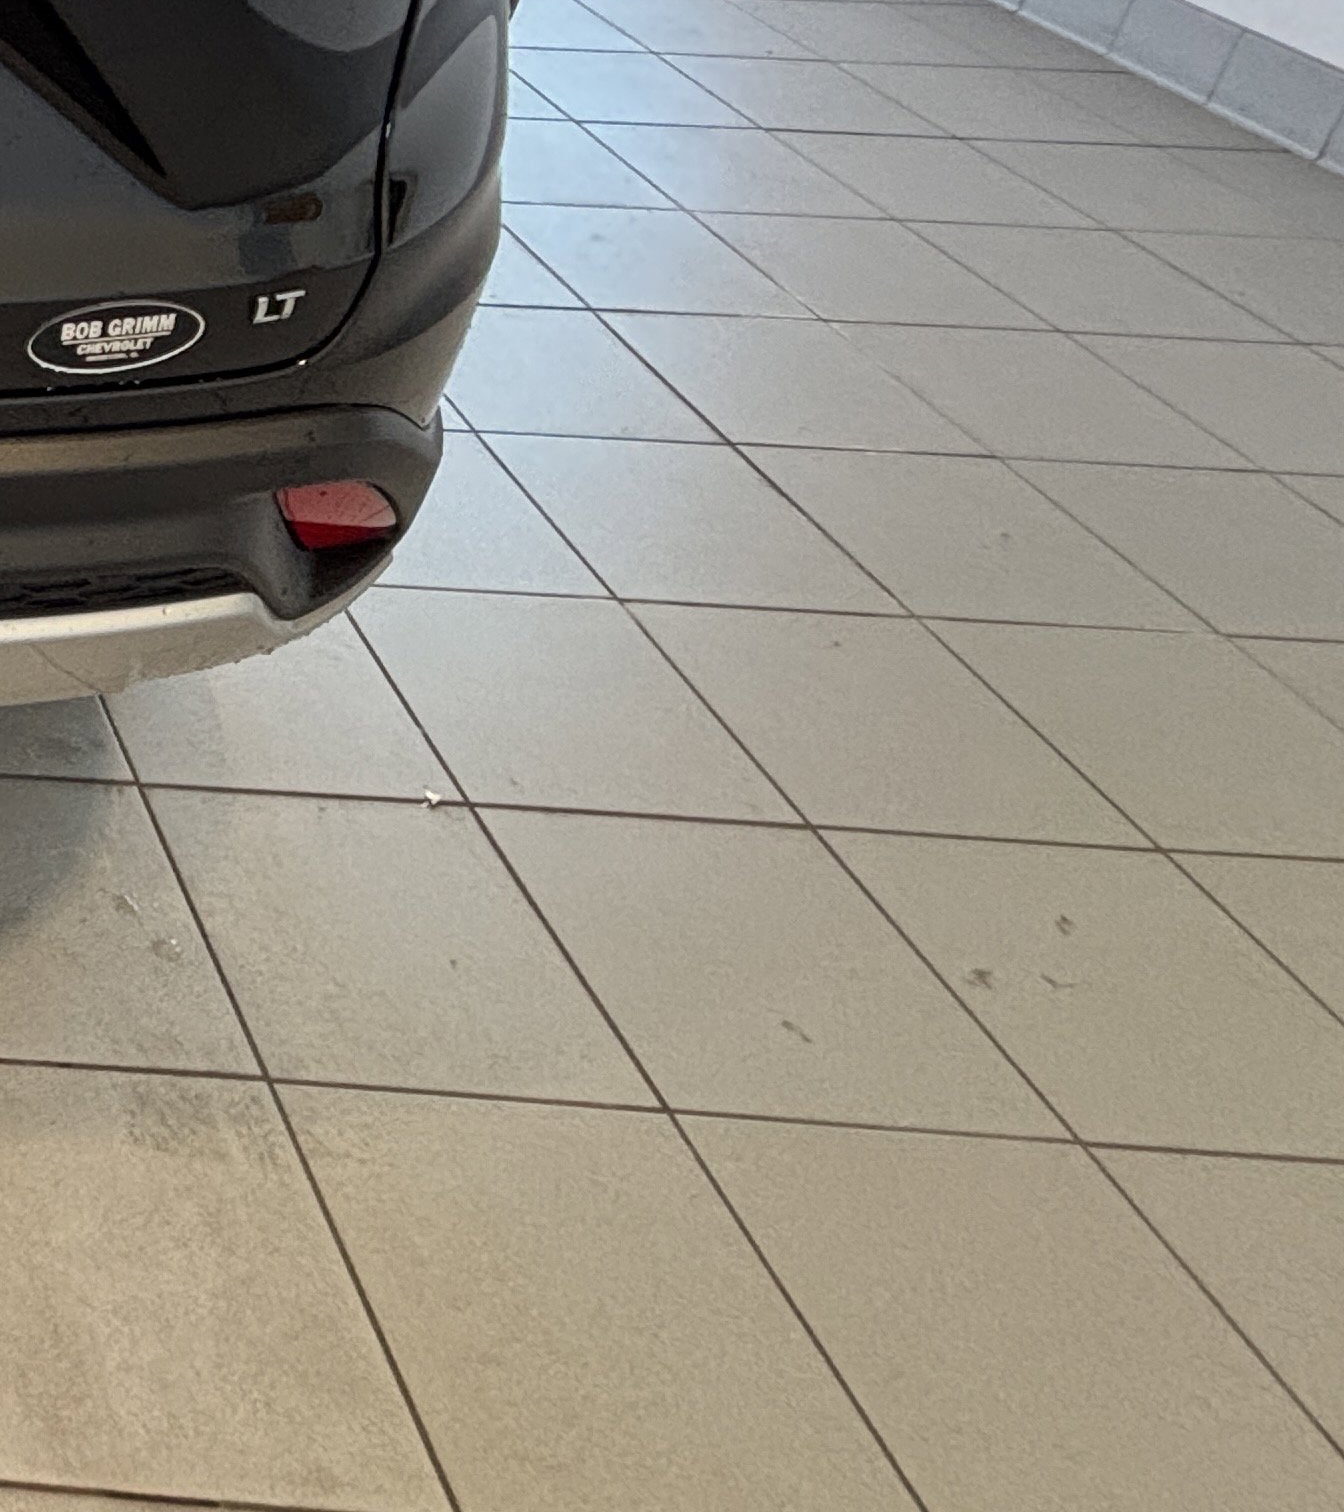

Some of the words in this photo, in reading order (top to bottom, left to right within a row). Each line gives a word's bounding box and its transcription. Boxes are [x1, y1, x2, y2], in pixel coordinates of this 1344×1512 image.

[252, 289, 307, 324] LT
[60, 320, 104, 342] BOB
[107, 313, 178, 336] GRIMM
[76, 337, 154, 356] CHEVROLET
